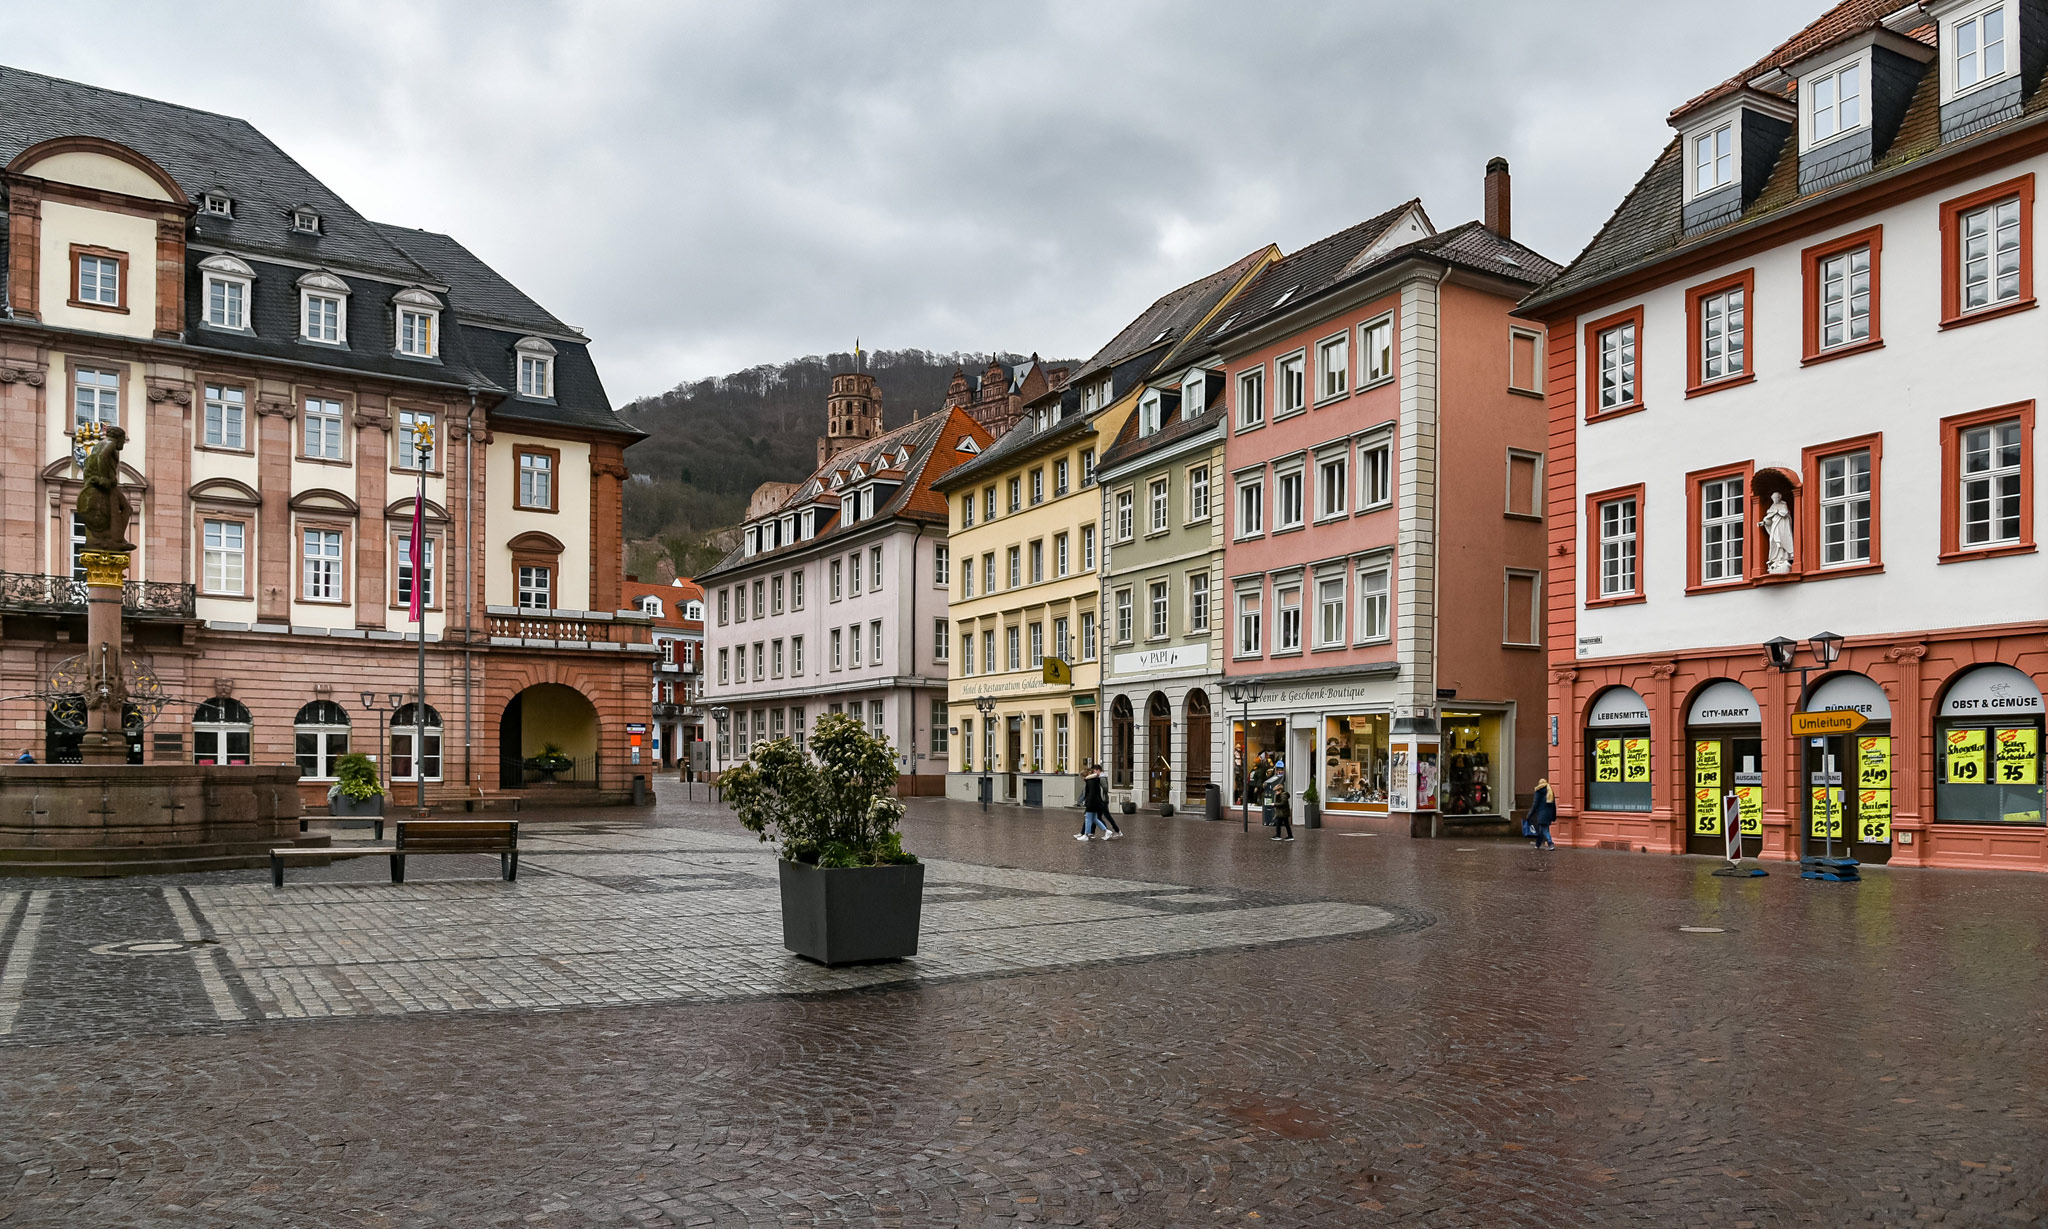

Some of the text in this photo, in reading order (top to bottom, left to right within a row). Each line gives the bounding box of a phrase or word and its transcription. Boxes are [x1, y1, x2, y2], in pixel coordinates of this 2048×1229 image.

[1150, 651, 1168, 663] PAPI
[962, 683, 978, 695] Hotel
[978, 686, 983, 694] &
[984, 681, 1020, 694] Restauration
[1280, 691, 1287, 702] &
[1288, 687, 1365, 703] Geschenk-Boutique
[1952, 696, 2038, 709] OBST & GEMÜSE
[1597, 711, 1649, 720] LEBENSMITTEL
[1701, 708, 1749, 718] CITY-MARKT
[1799, 717, 1852, 729] Umleitung
[2003, 765, 2025, 781] 75
[1698, 816, 1717, 831] 55
[1864, 823, 1885, 837] 65
